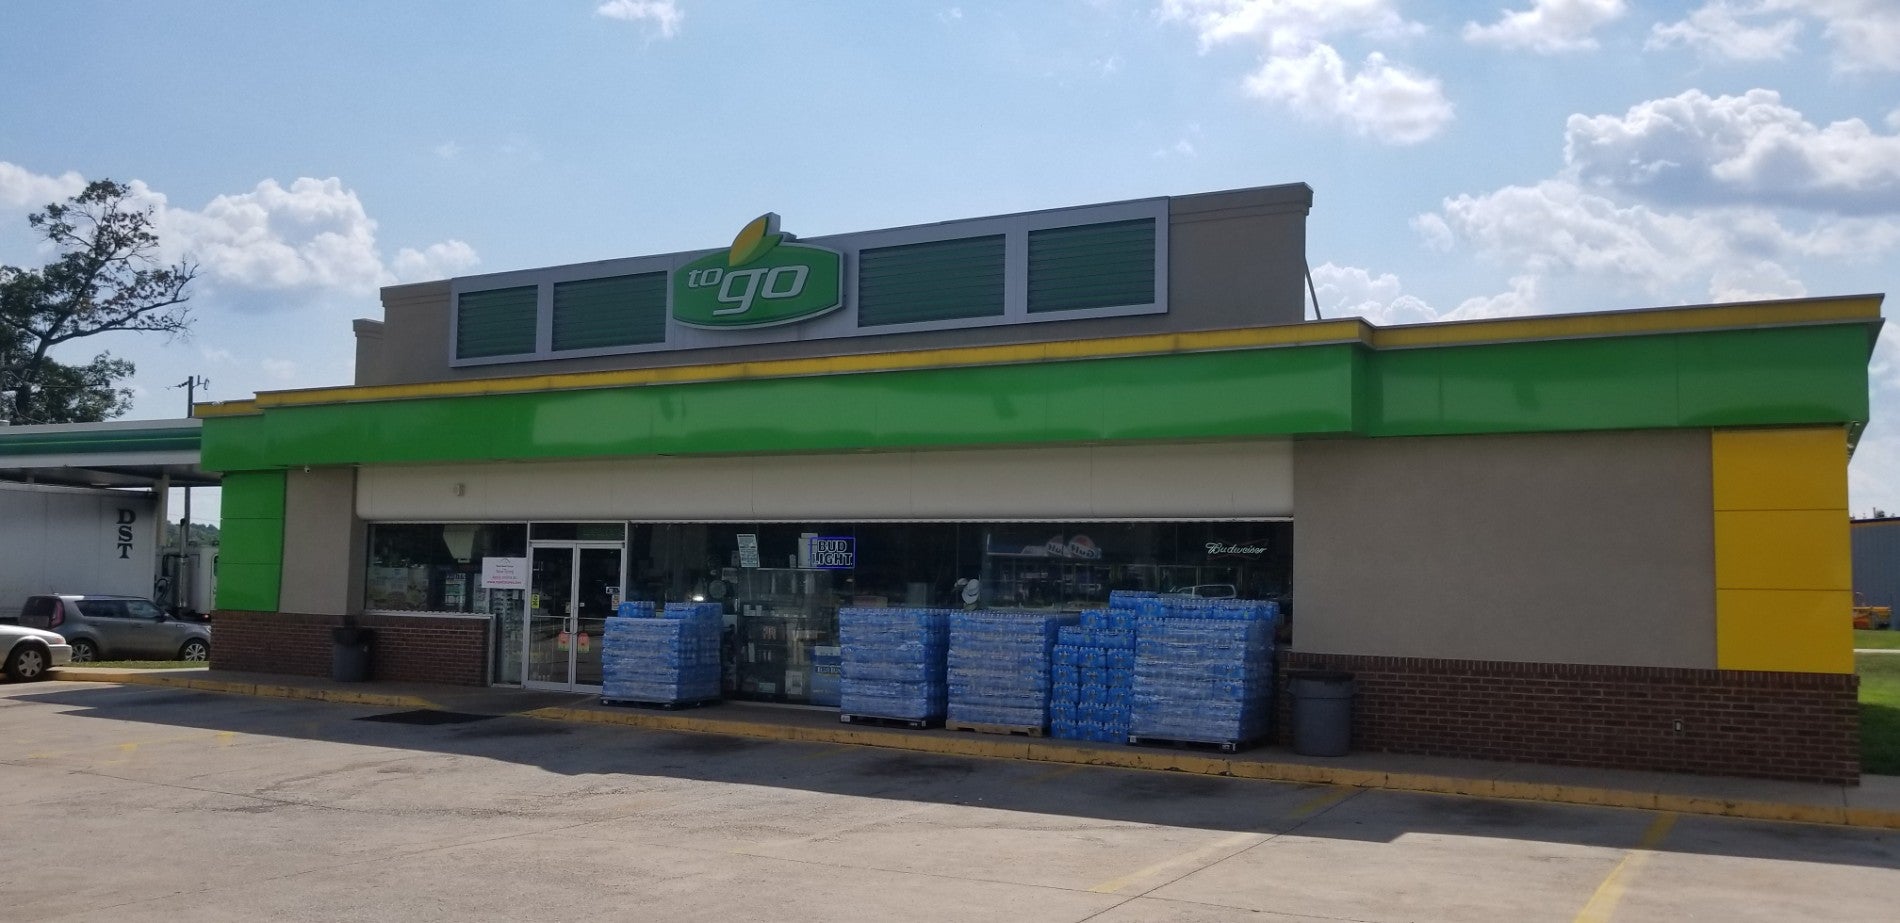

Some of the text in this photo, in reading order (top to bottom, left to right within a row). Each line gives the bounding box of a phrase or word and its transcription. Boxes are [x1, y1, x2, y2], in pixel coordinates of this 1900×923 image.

[688, 265, 809, 316] to go
[116, 509, 136, 559] DST
[817, 539, 847, 553] BUD
[1205, 542, 1267, 555] Budweiser
[812, 553, 852, 565] LIGHT
